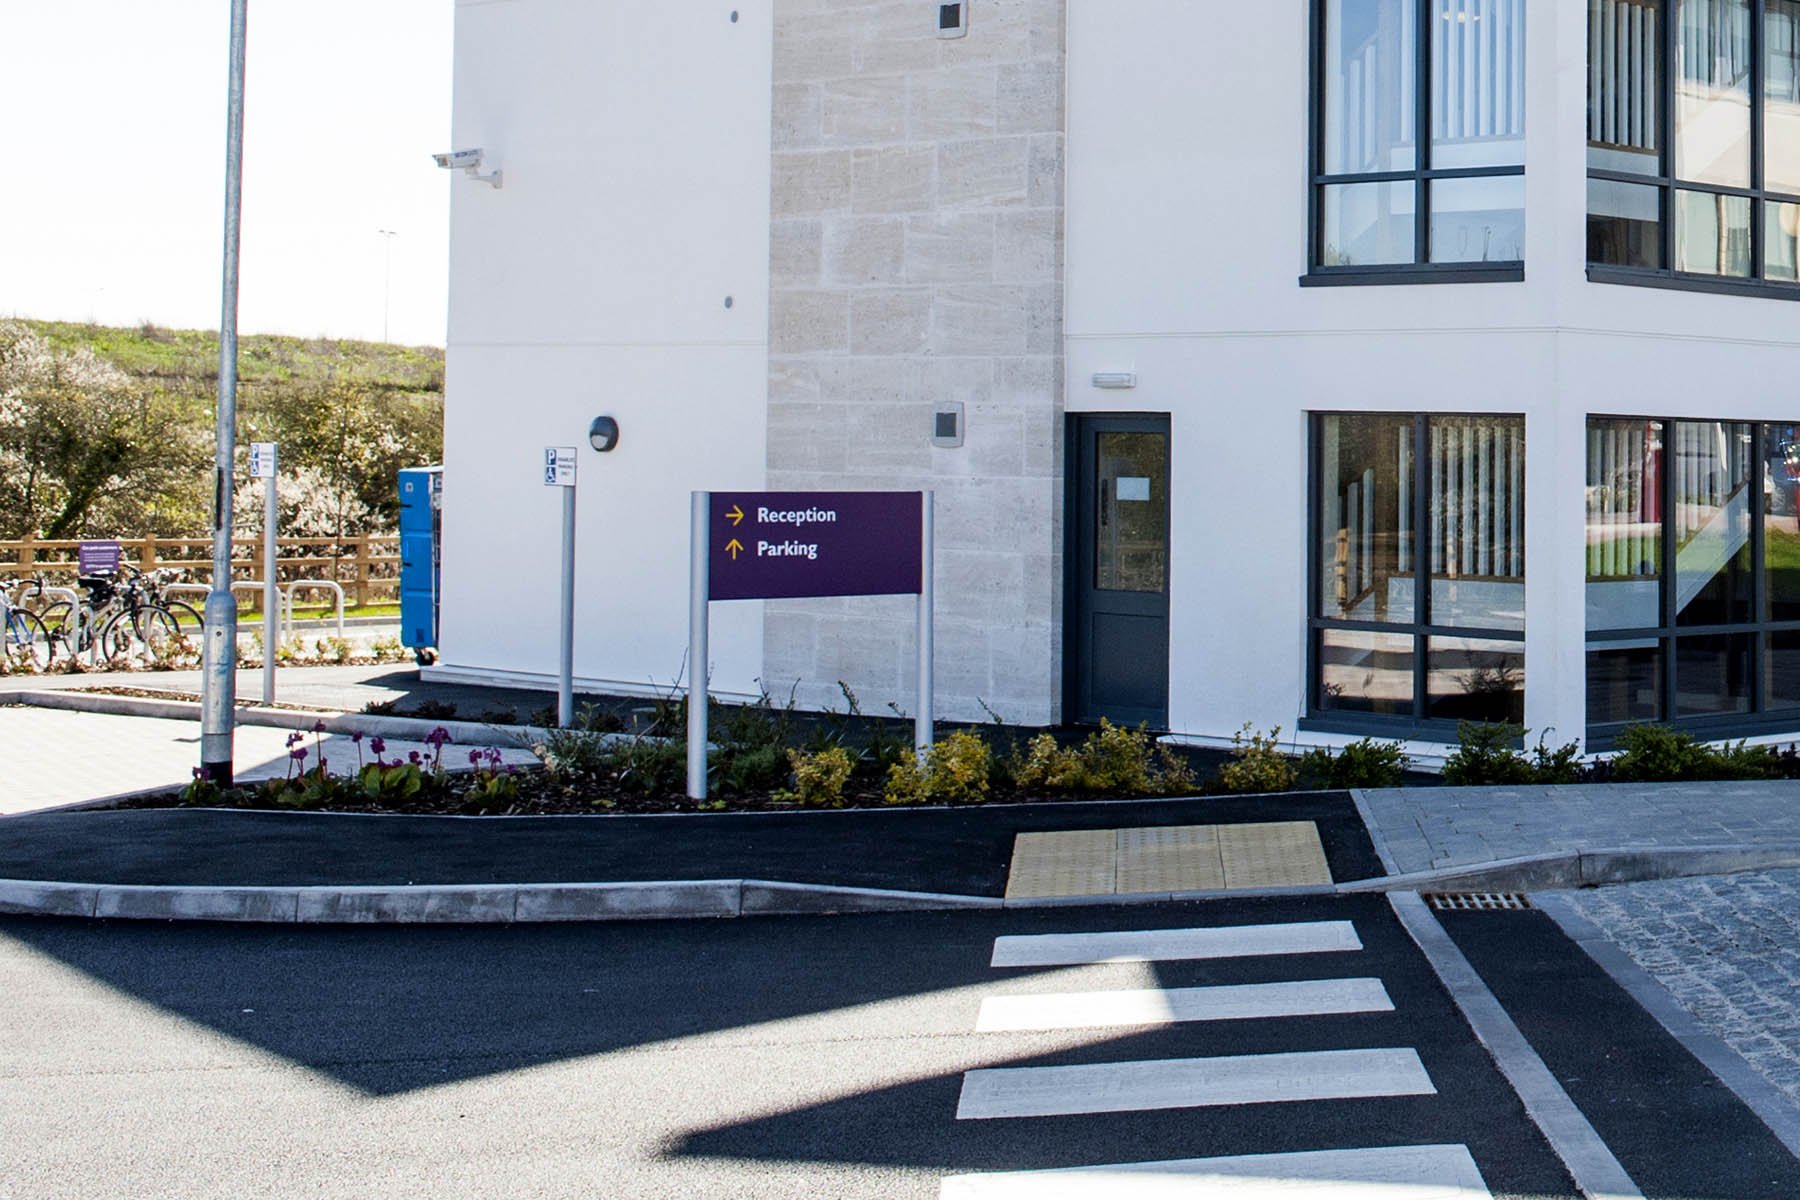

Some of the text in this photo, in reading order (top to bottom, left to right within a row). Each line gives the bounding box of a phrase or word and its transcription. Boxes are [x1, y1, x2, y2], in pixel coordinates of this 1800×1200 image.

[548, 450, 556, 465] P
[757, 507, 837, 526] Reception
[757, 540, 818, 559] Parking
